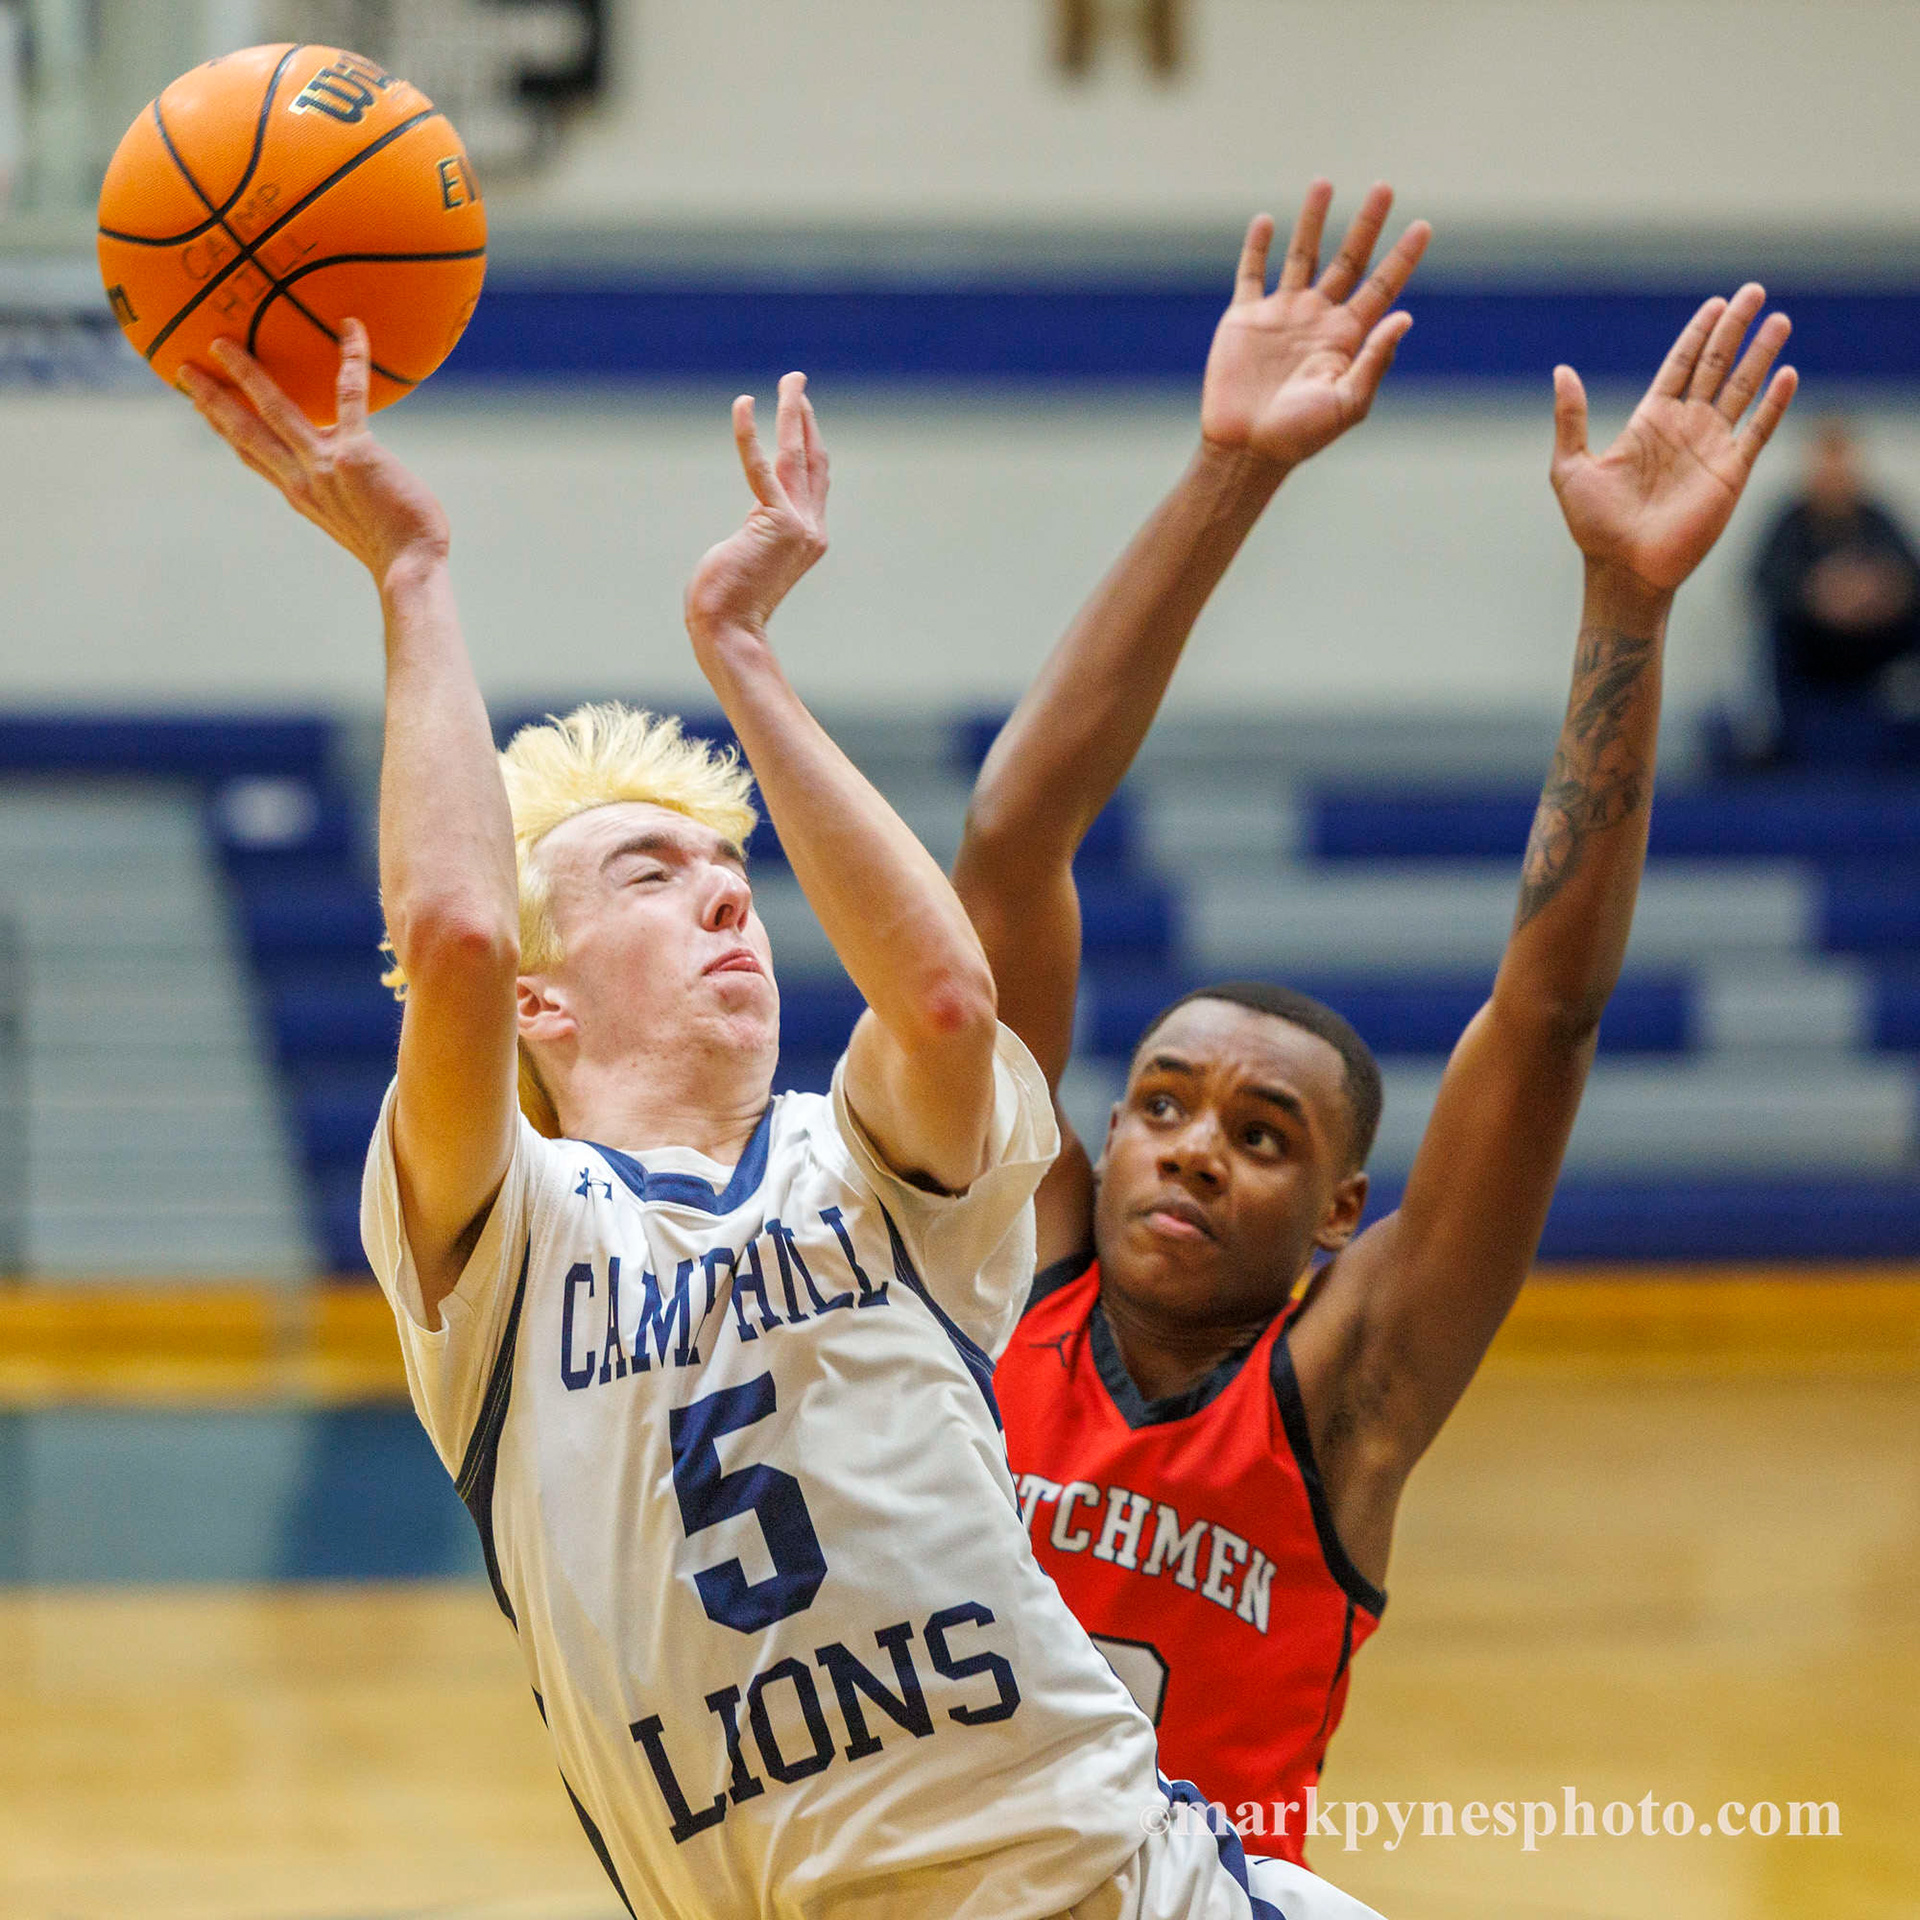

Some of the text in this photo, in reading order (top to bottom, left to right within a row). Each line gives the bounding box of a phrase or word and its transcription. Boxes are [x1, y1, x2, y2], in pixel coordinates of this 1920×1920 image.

[181, 182, 281, 281] CAMP
[668, 1371, 828, 1635] 5
[1012, 1472, 1277, 1636] TCHMEN
[629, 1601, 1021, 1845] LIONS
